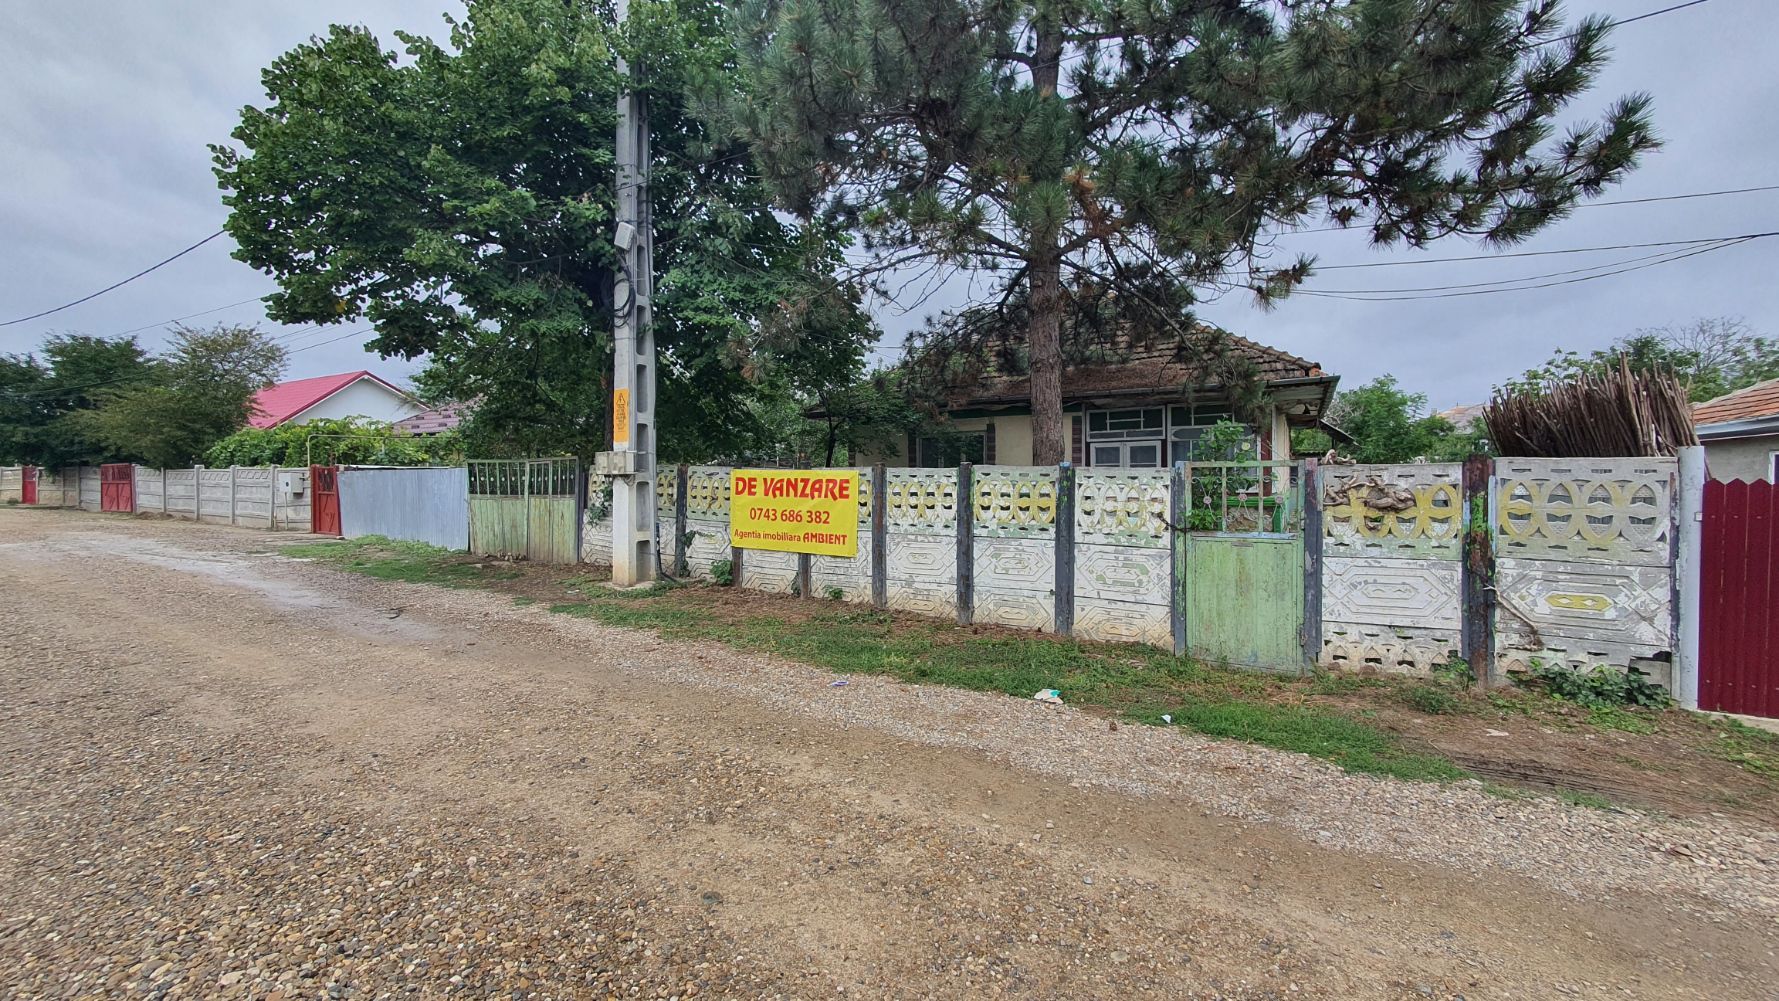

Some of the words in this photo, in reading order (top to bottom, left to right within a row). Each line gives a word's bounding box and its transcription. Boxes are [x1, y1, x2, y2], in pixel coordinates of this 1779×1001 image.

[735, 477, 757, 496] DE
[763, 478, 850, 501] VANZARE
[750, 508, 777, 521] 0743
[781, 509, 802, 523] 686
[807, 511, 830, 524] 382
[734, 529, 760, 539] Agentia
[763, 531, 800, 542] imobiliara
[803, 533, 847, 545] AMBIENT
